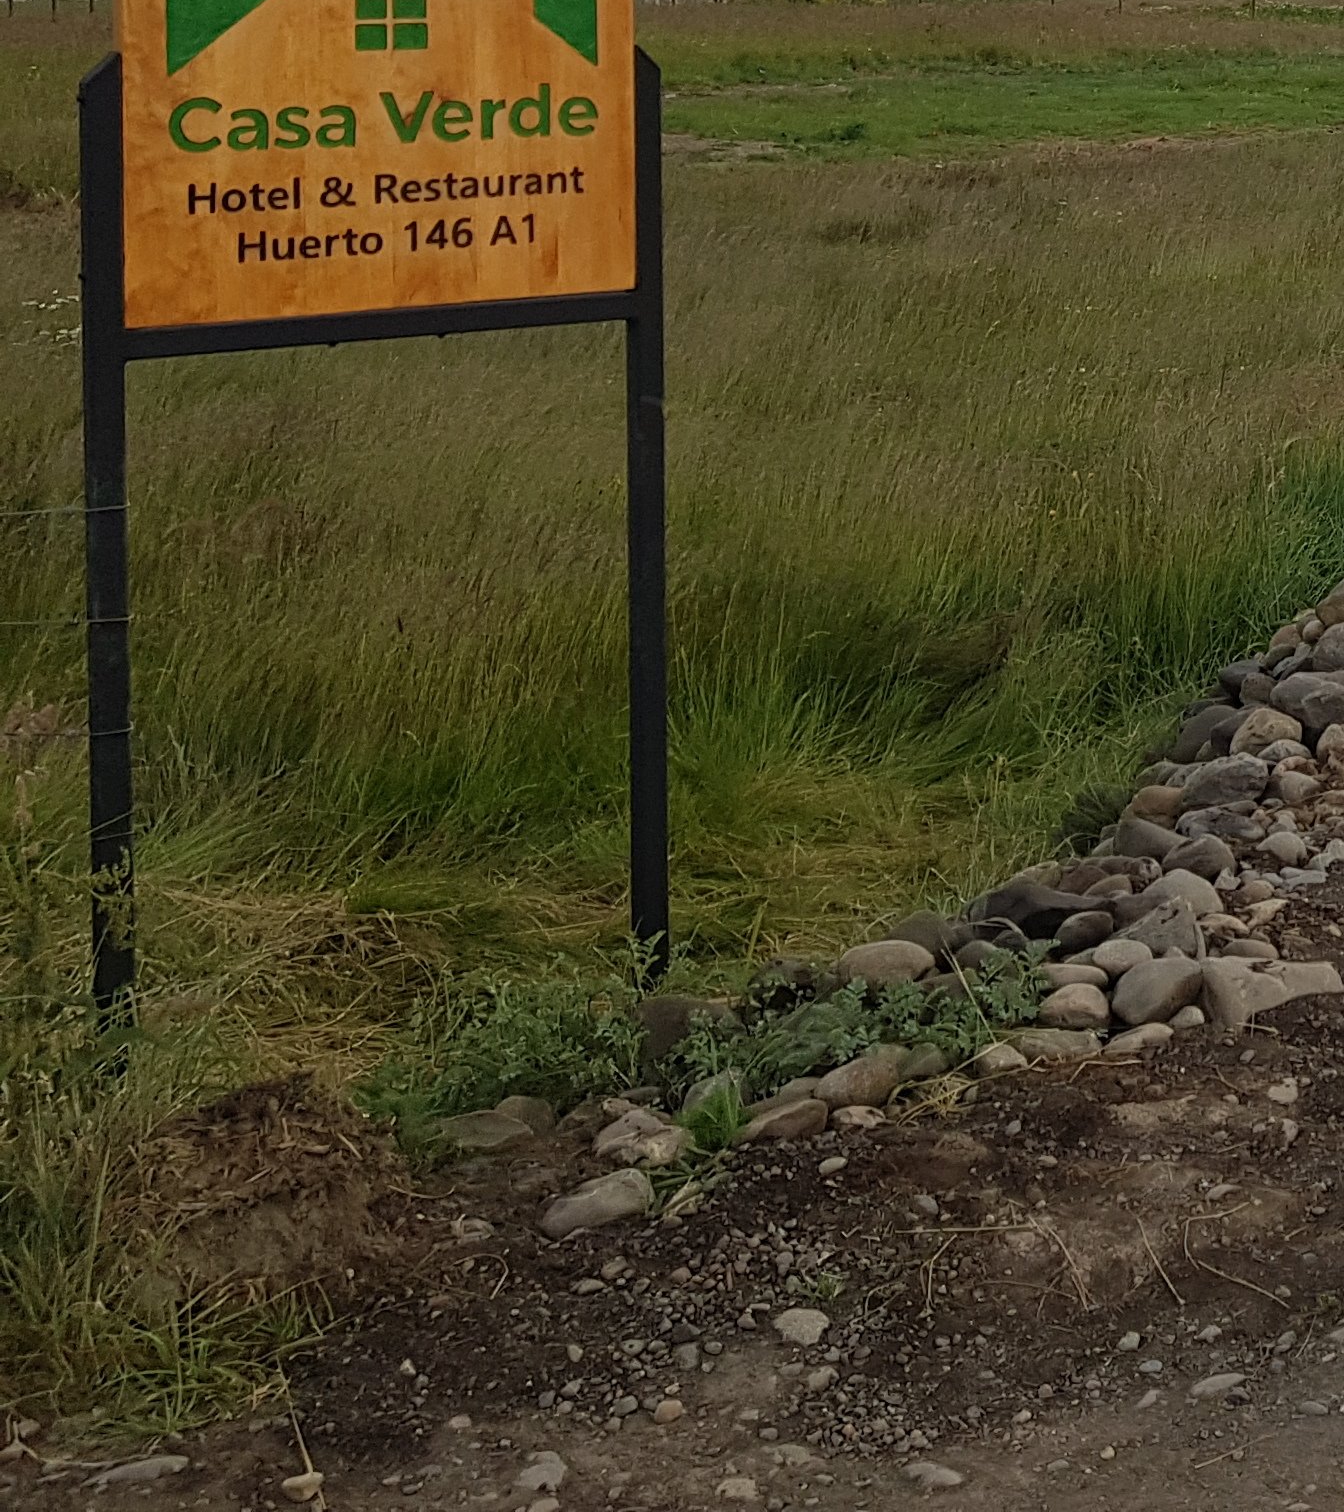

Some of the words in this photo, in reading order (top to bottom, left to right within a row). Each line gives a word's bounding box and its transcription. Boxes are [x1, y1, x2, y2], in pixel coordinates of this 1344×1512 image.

[169, 97, 357, 152] Casa
[379, 83, 599, 144] Verde
[186, 177, 301, 215] Hotel
[319, 176, 356, 208] &
[374, 166, 585, 204] Restaurant
[237, 228, 384, 264] Huerto
[403, 217, 474, 253] 146
[489, 213, 537, 246] A1
